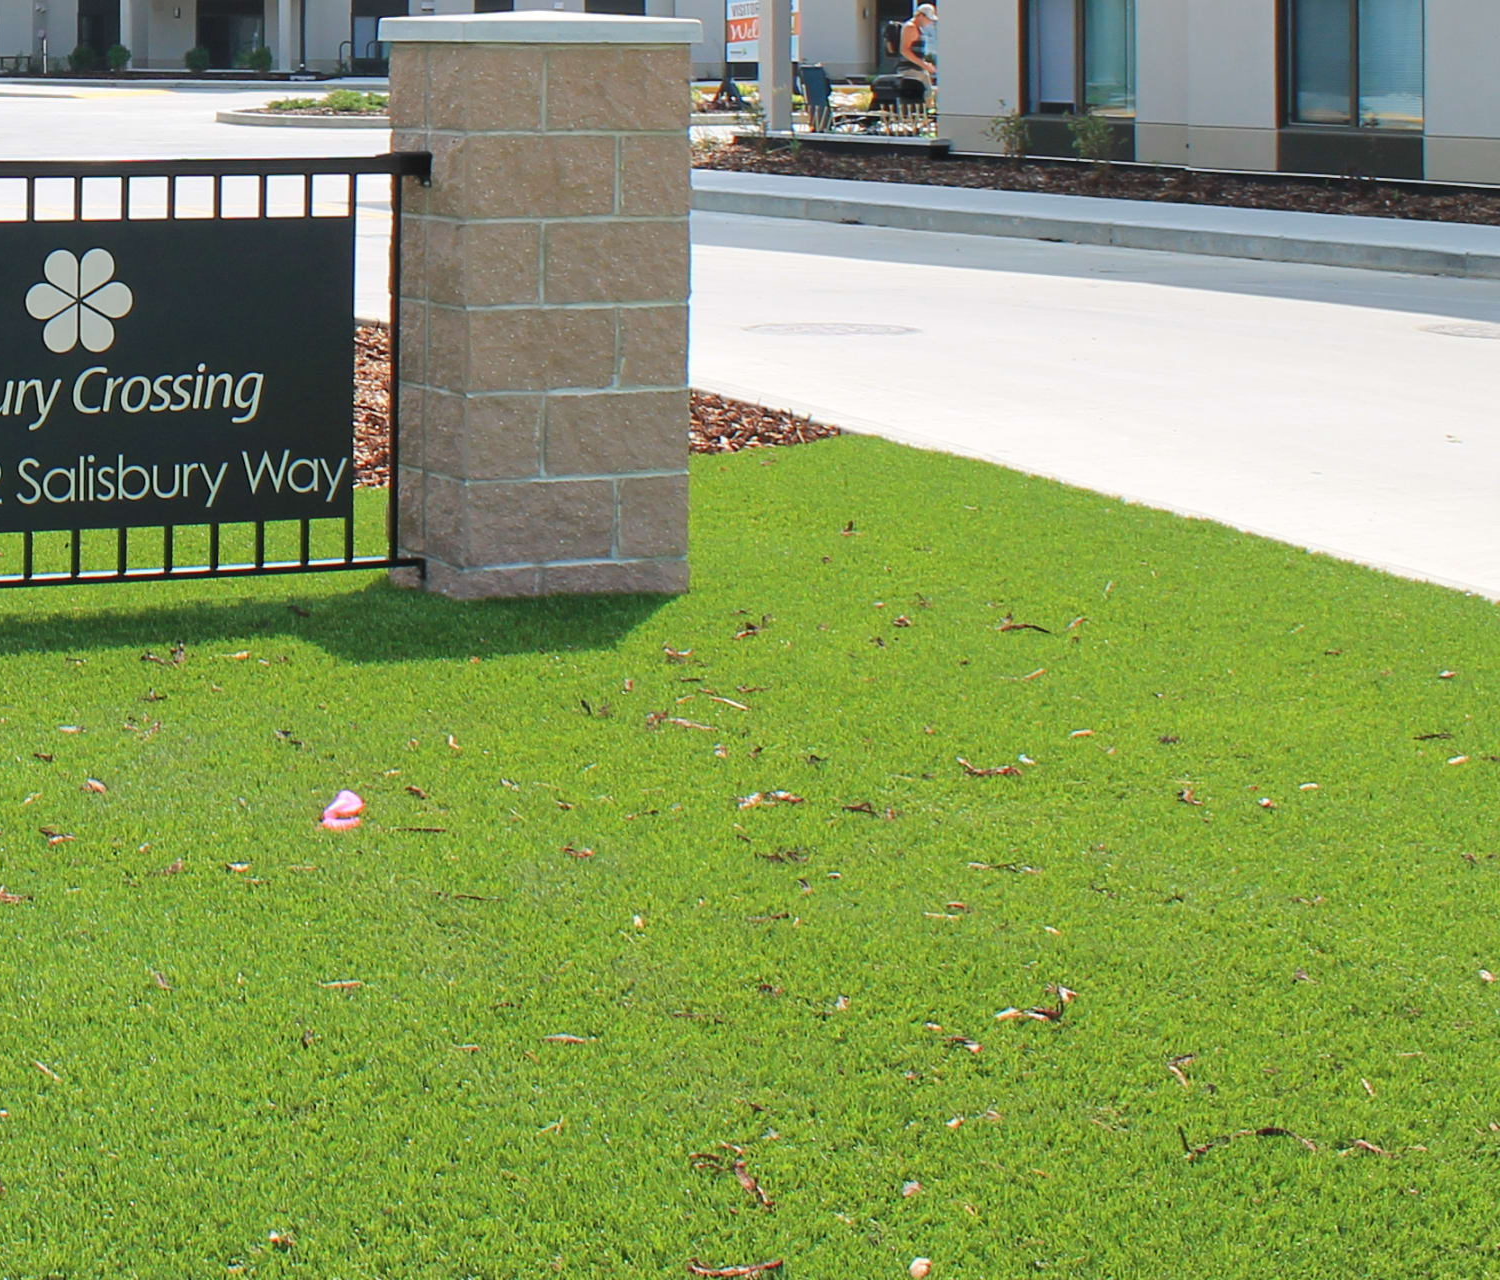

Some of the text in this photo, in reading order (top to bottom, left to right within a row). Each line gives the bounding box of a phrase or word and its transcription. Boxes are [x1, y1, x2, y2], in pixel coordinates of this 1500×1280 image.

[71, 363, 265, 424] Crossing
[15, 453, 229, 508] Salisbury
[241, 448, 348, 503] Way
